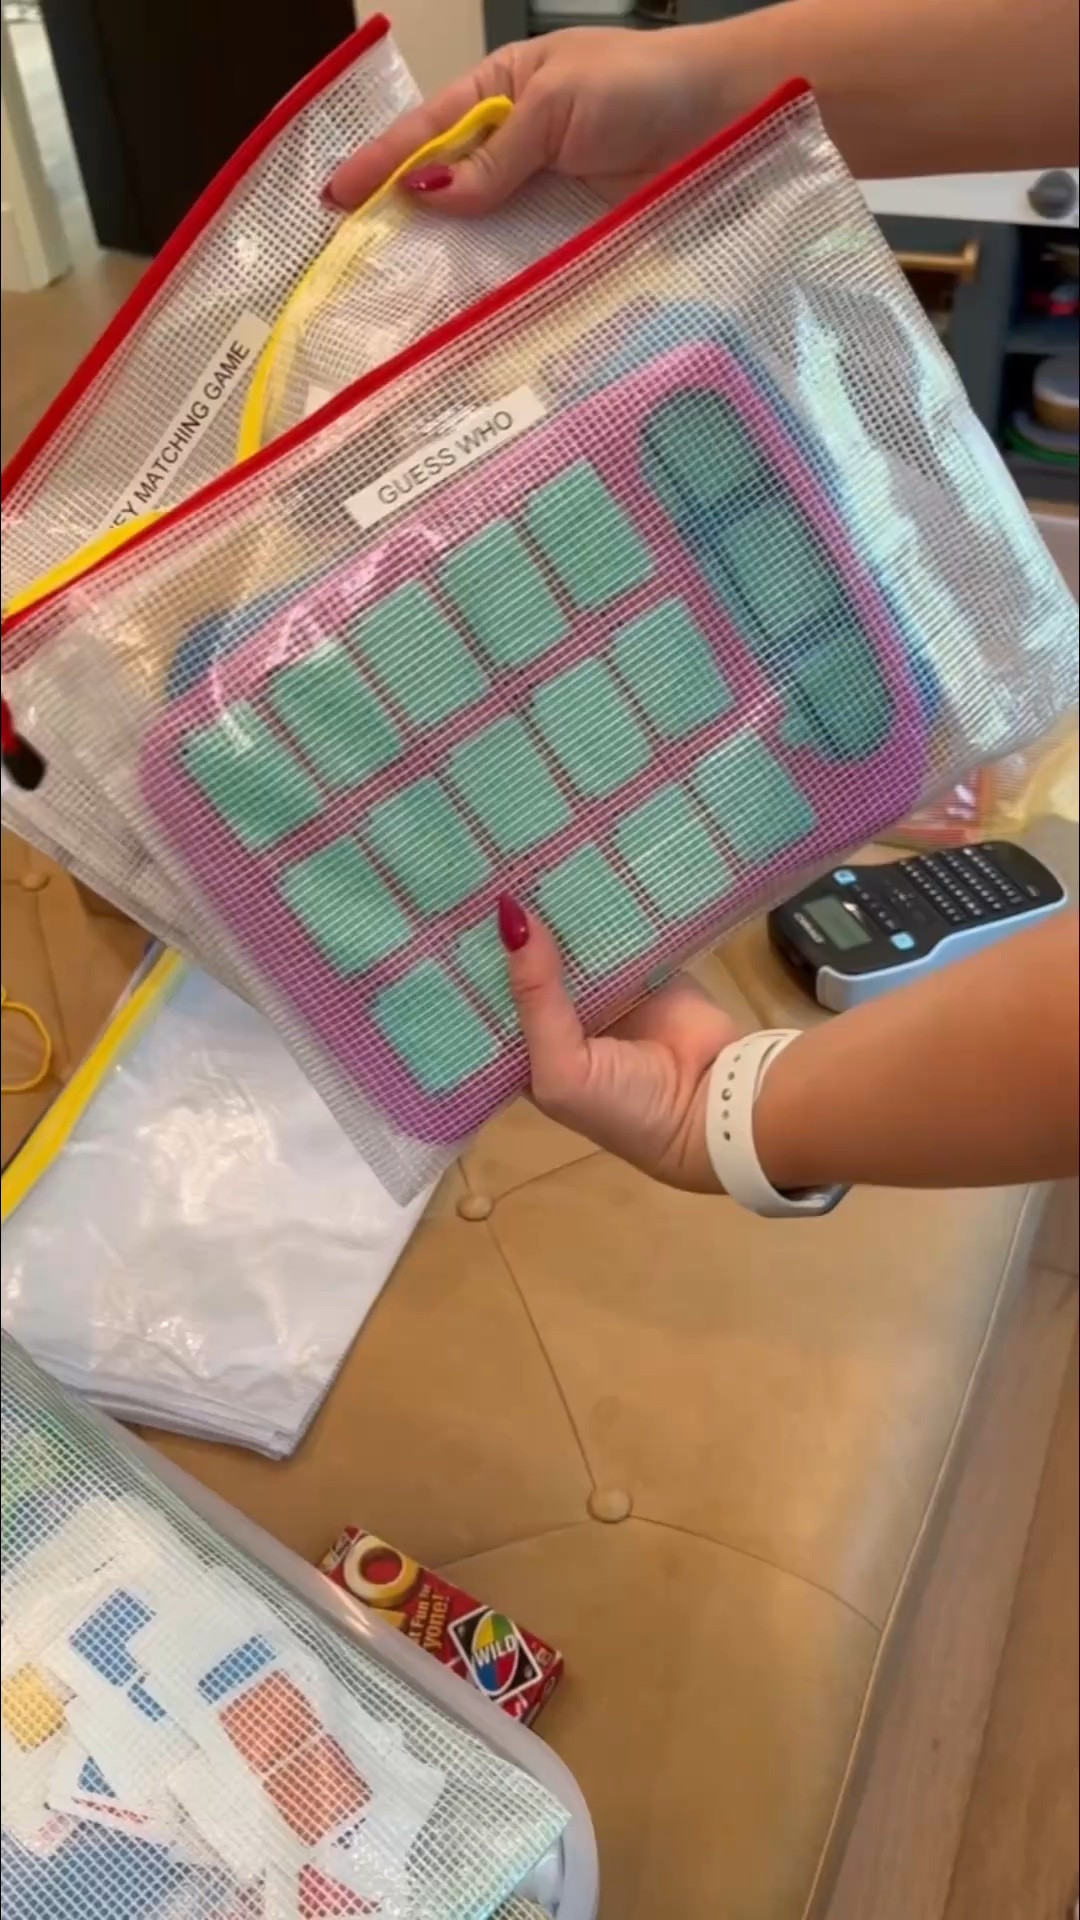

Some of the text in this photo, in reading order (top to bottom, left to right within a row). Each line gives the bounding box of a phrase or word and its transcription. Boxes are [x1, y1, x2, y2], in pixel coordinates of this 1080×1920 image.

[109, 340, 251, 528] EY MATCHING GAME
[377, 410, 513, 504] GUESS WHO
[473, 1633, 518, 1669] WILD
